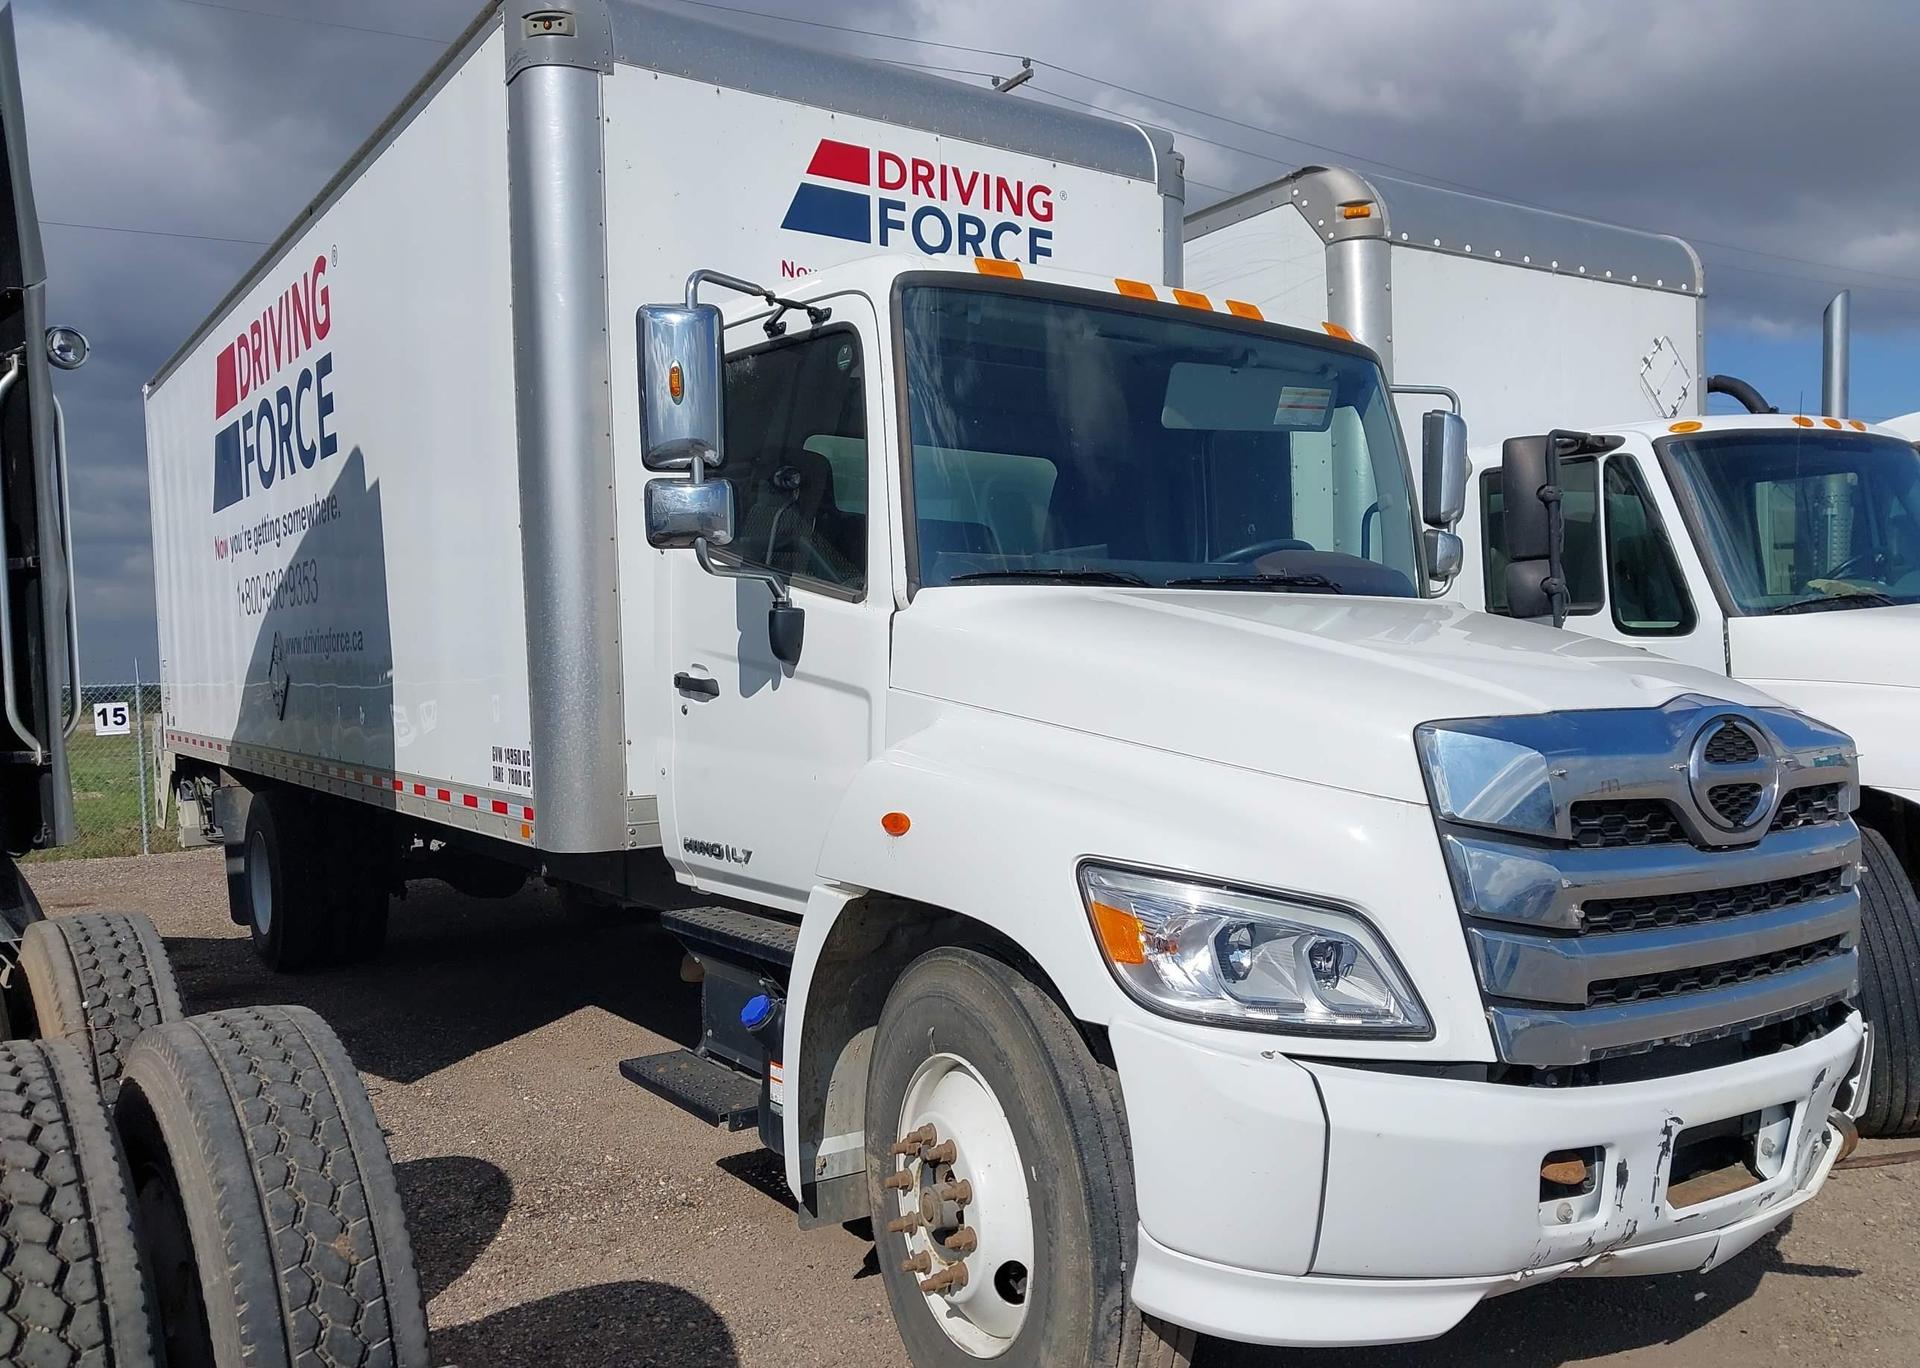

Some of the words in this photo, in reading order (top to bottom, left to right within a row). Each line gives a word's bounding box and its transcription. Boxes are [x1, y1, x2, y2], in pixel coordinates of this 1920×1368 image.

[878, 150, 1054, 222] DRIVING
[781, 259, 818, 279] No
[237, 255, 332, 402] DRIVING
[241, 351, 338, 498] FORCE
[214, 535, 229, 561] Now
[230, 524, 252, 563] you're
[253, 513, 281, 555] getting
[97, 707, 127, 727] 15
